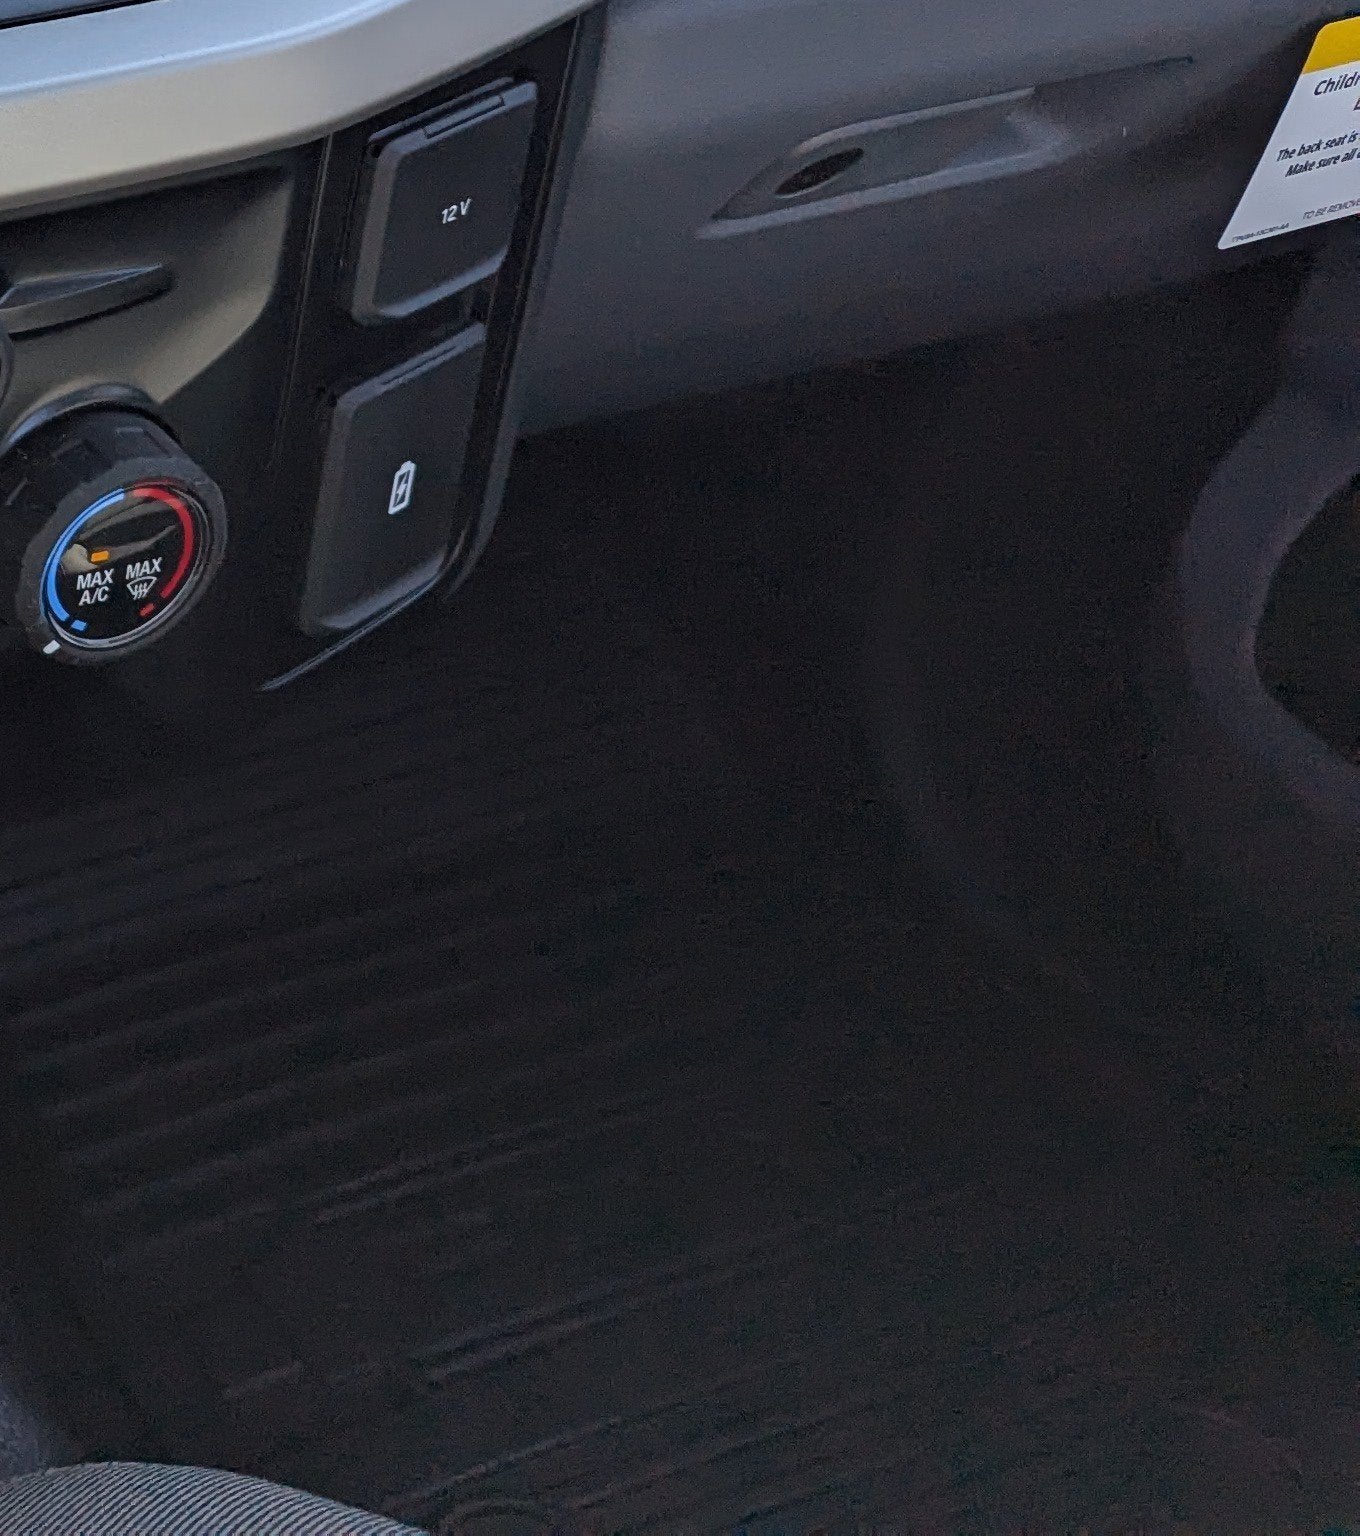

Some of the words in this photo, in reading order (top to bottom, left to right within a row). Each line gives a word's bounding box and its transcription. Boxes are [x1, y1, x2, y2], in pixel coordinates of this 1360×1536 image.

[1277, 148, 1296, 161] The
[1297, 139, 1324, 156] back
[1323, 135, 1348, 150] seat
[1285, 160, 1316, 177] Make
[1316, 155, 1340, 169] sure
[1341, 148, 1358, 162] all
[442, 204, 458, 224] 12
[460, 198, 472, 216] V
[76, 567, 115, 591] MAX
[125, 556, 163, 580] MAX
[77, 585, 110, 606] A/C
